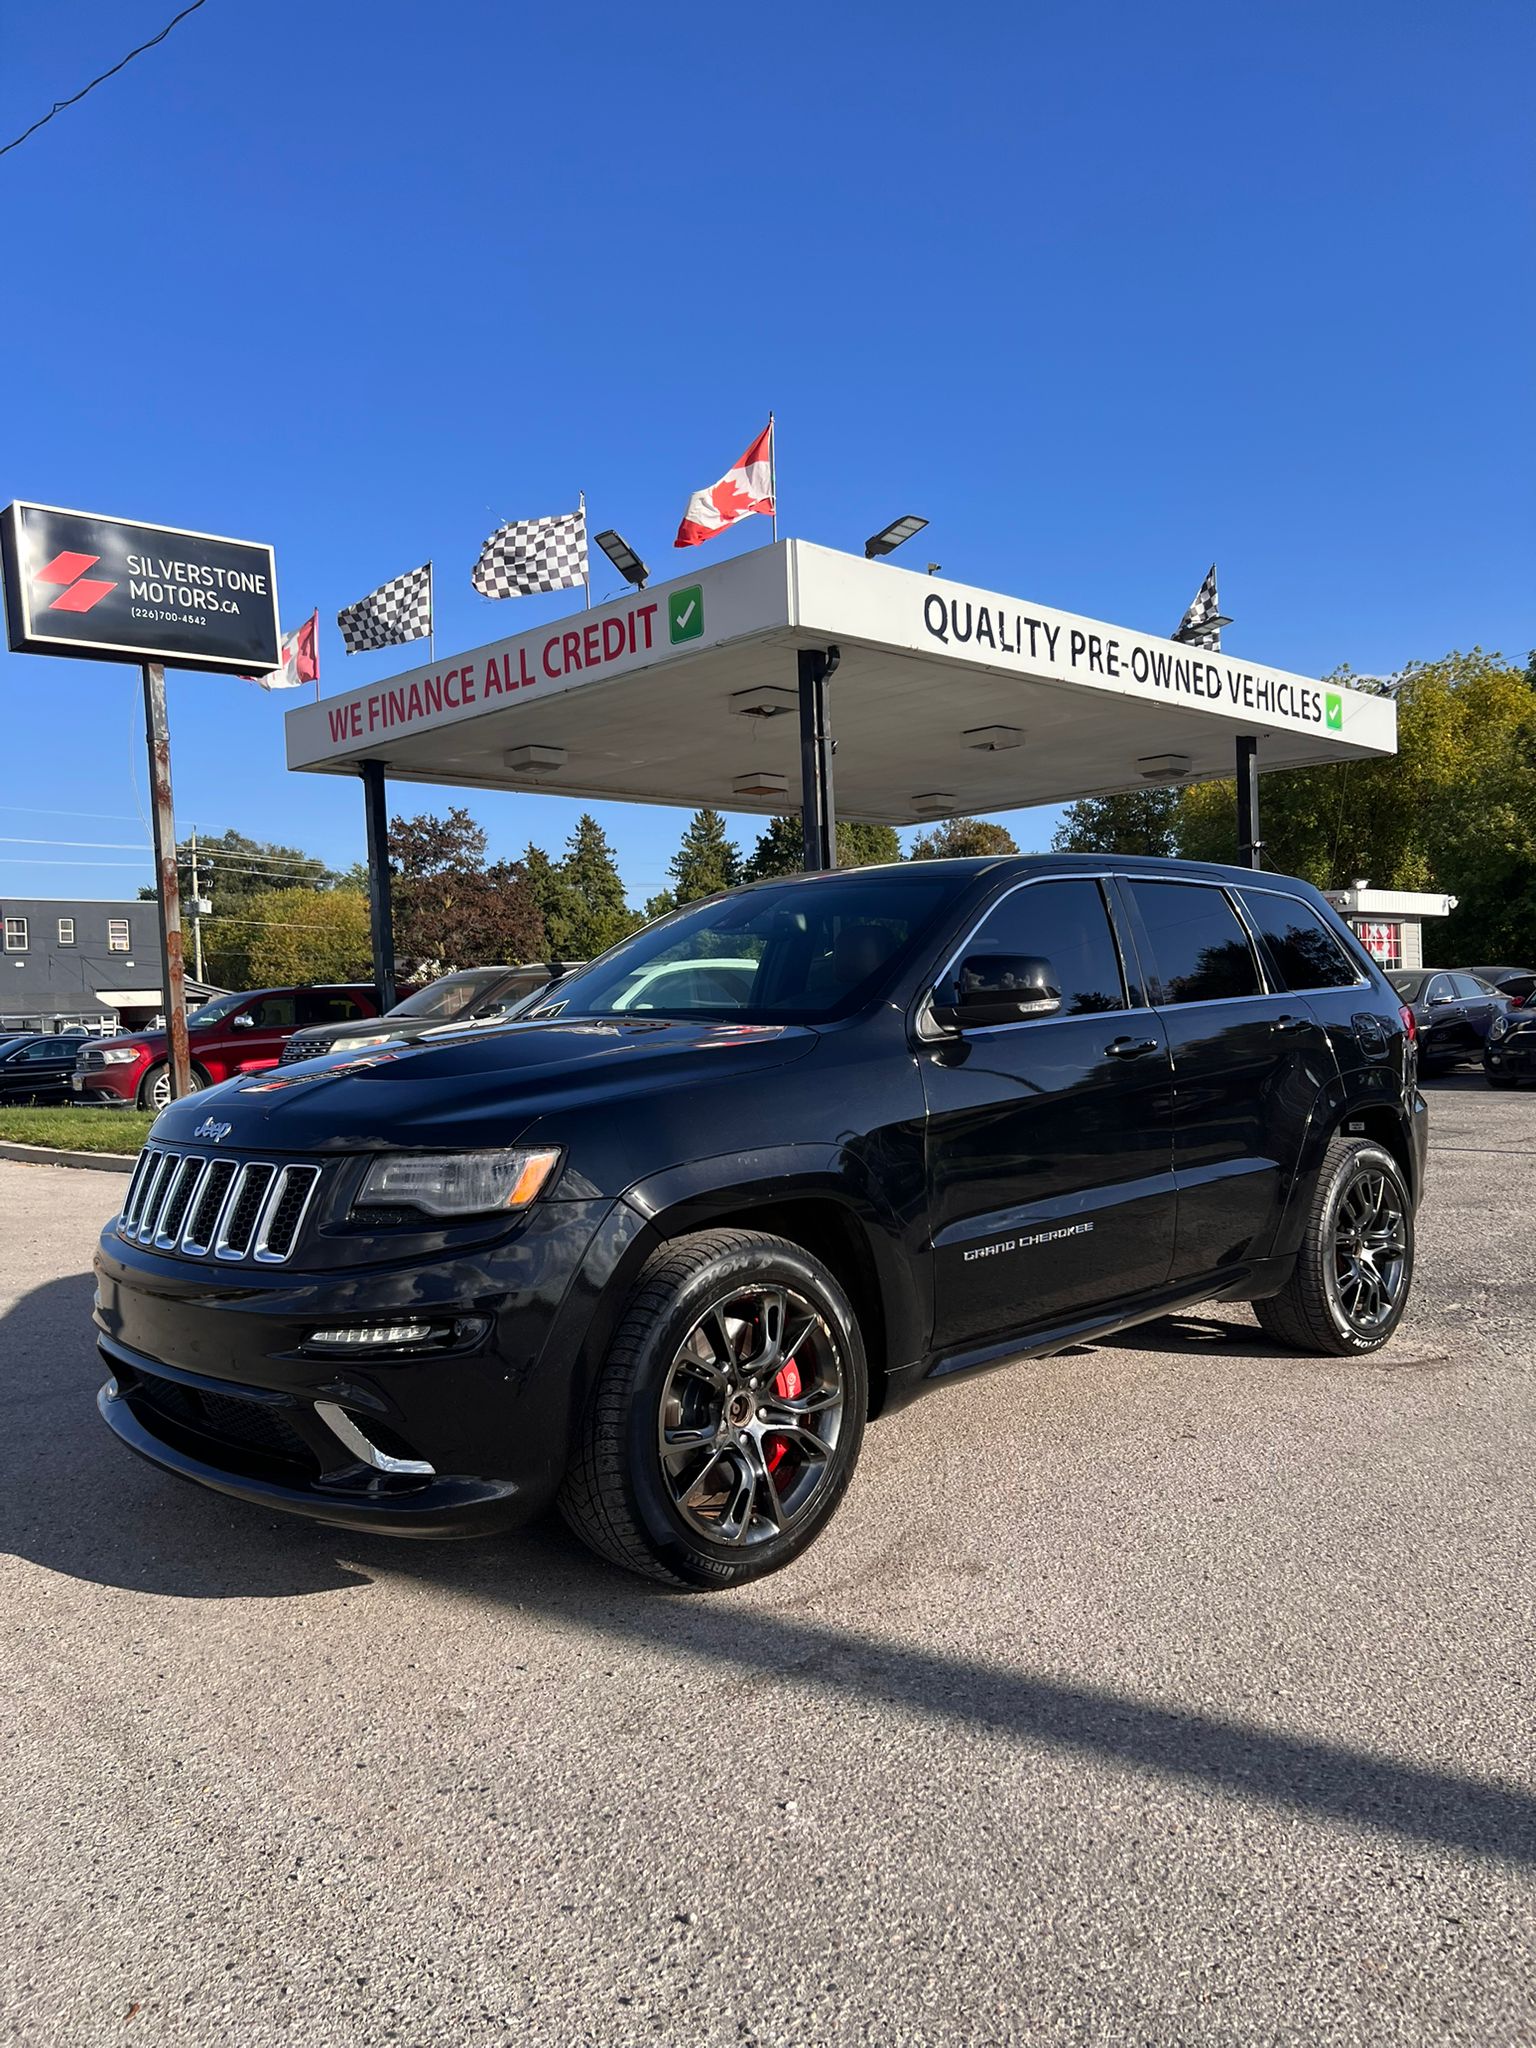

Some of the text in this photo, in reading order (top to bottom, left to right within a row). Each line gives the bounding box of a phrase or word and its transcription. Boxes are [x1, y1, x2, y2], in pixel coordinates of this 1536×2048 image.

[126, 555, 267, 595] SILVERSTONE
[129, 579, 240, 615] MOTORS.CA
[131, 606, 207, 626] (226)700-4542
[328, 603, 658, 743] WE FINANCE ALL CREDIT
[924, 593, 1322, 723] QUALITY PRE-OWNED VEHICLES
[194, 1116, 232, 1143] Jeep
[963, 1221, 1094, 1261] GRAND CHEROKEE
